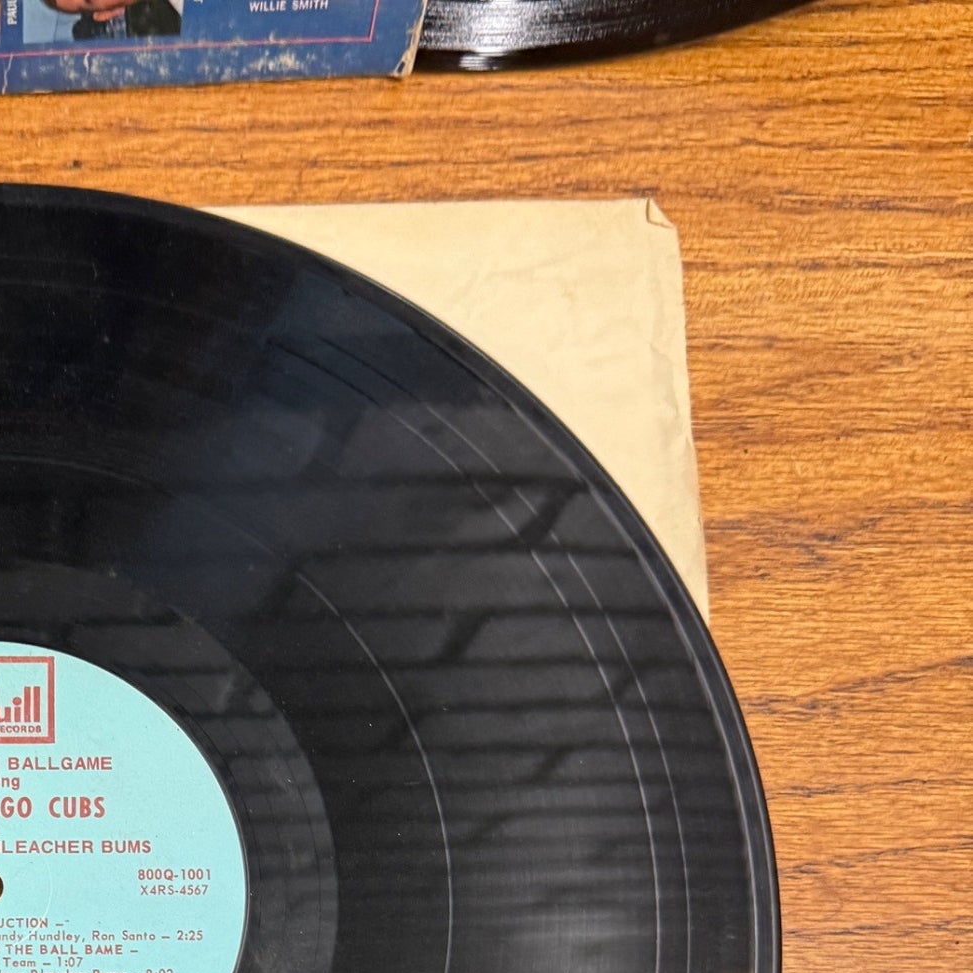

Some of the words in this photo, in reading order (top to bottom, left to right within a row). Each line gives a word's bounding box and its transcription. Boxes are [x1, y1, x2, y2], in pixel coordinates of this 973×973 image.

[249, 1, 287, 12] WILLIE
[292, 0, 328, 11] SMITH
[8, 756, 112, 770] BALLGAME
[49, 796, 105, 818] CUBS
[101, 840, 151, 853] BUMS
[138, 869, 210, 881] 800Q-1001
[141, 884, 208, 895] X4RS-4567
[29, 930, 85, 943] Hundley,
[92, 930, 115, 941] Ron
[122, 930, 155, 941] Santo
[177, 930, 203, 941] 2:25
[5, 944, 33, 955] THE
[40, 944, 78, 955] BALL
[85, 944, 123, 955] BAME
[2, 957, 36, 967] Team
[58, 956, 83, 968] 1:07
